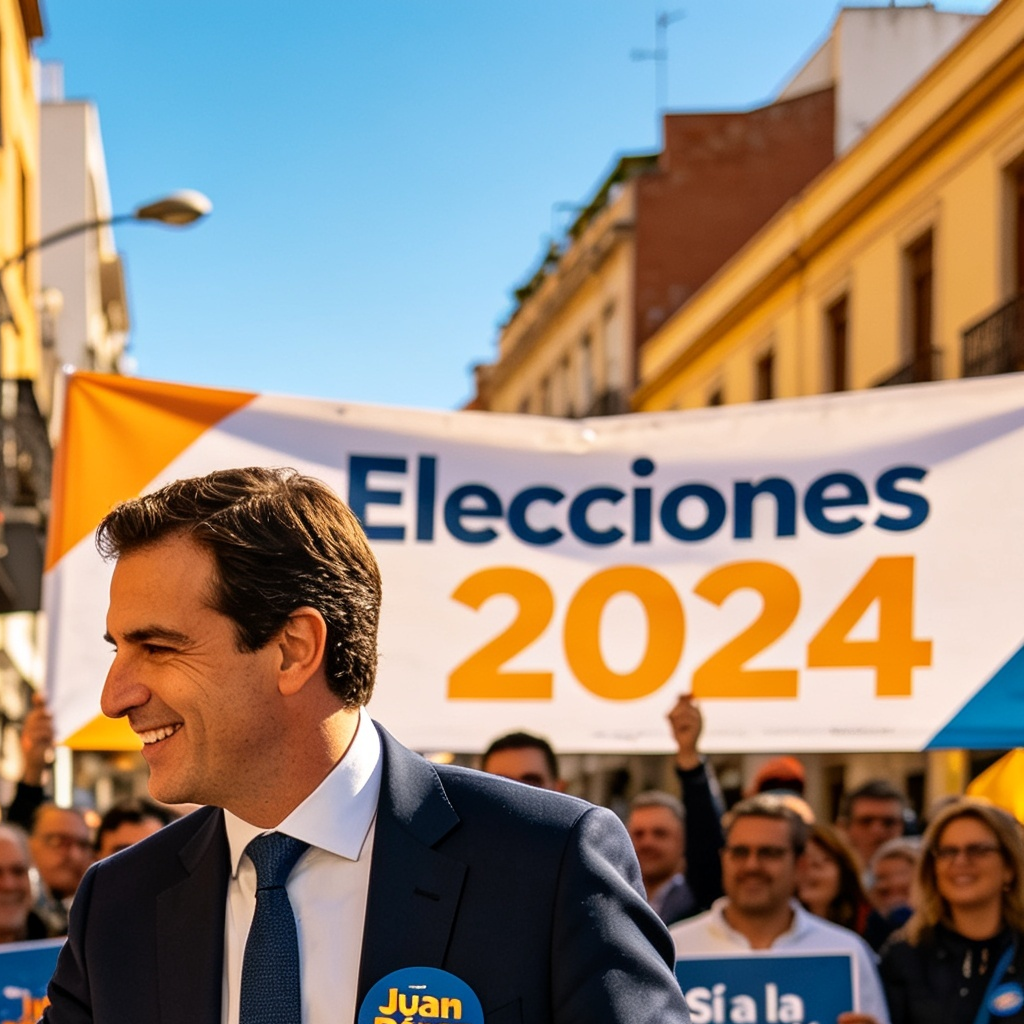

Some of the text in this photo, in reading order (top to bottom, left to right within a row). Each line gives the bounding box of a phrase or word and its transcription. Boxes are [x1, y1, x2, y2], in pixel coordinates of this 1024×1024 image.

[347, 454, 931, 546] Elecciones
[446, 555, 933, 702] 2024
[378, 988, 462, 1019] Juan
[729, 994, 757, 1024] a
[765, 982, 804, 1024] la
